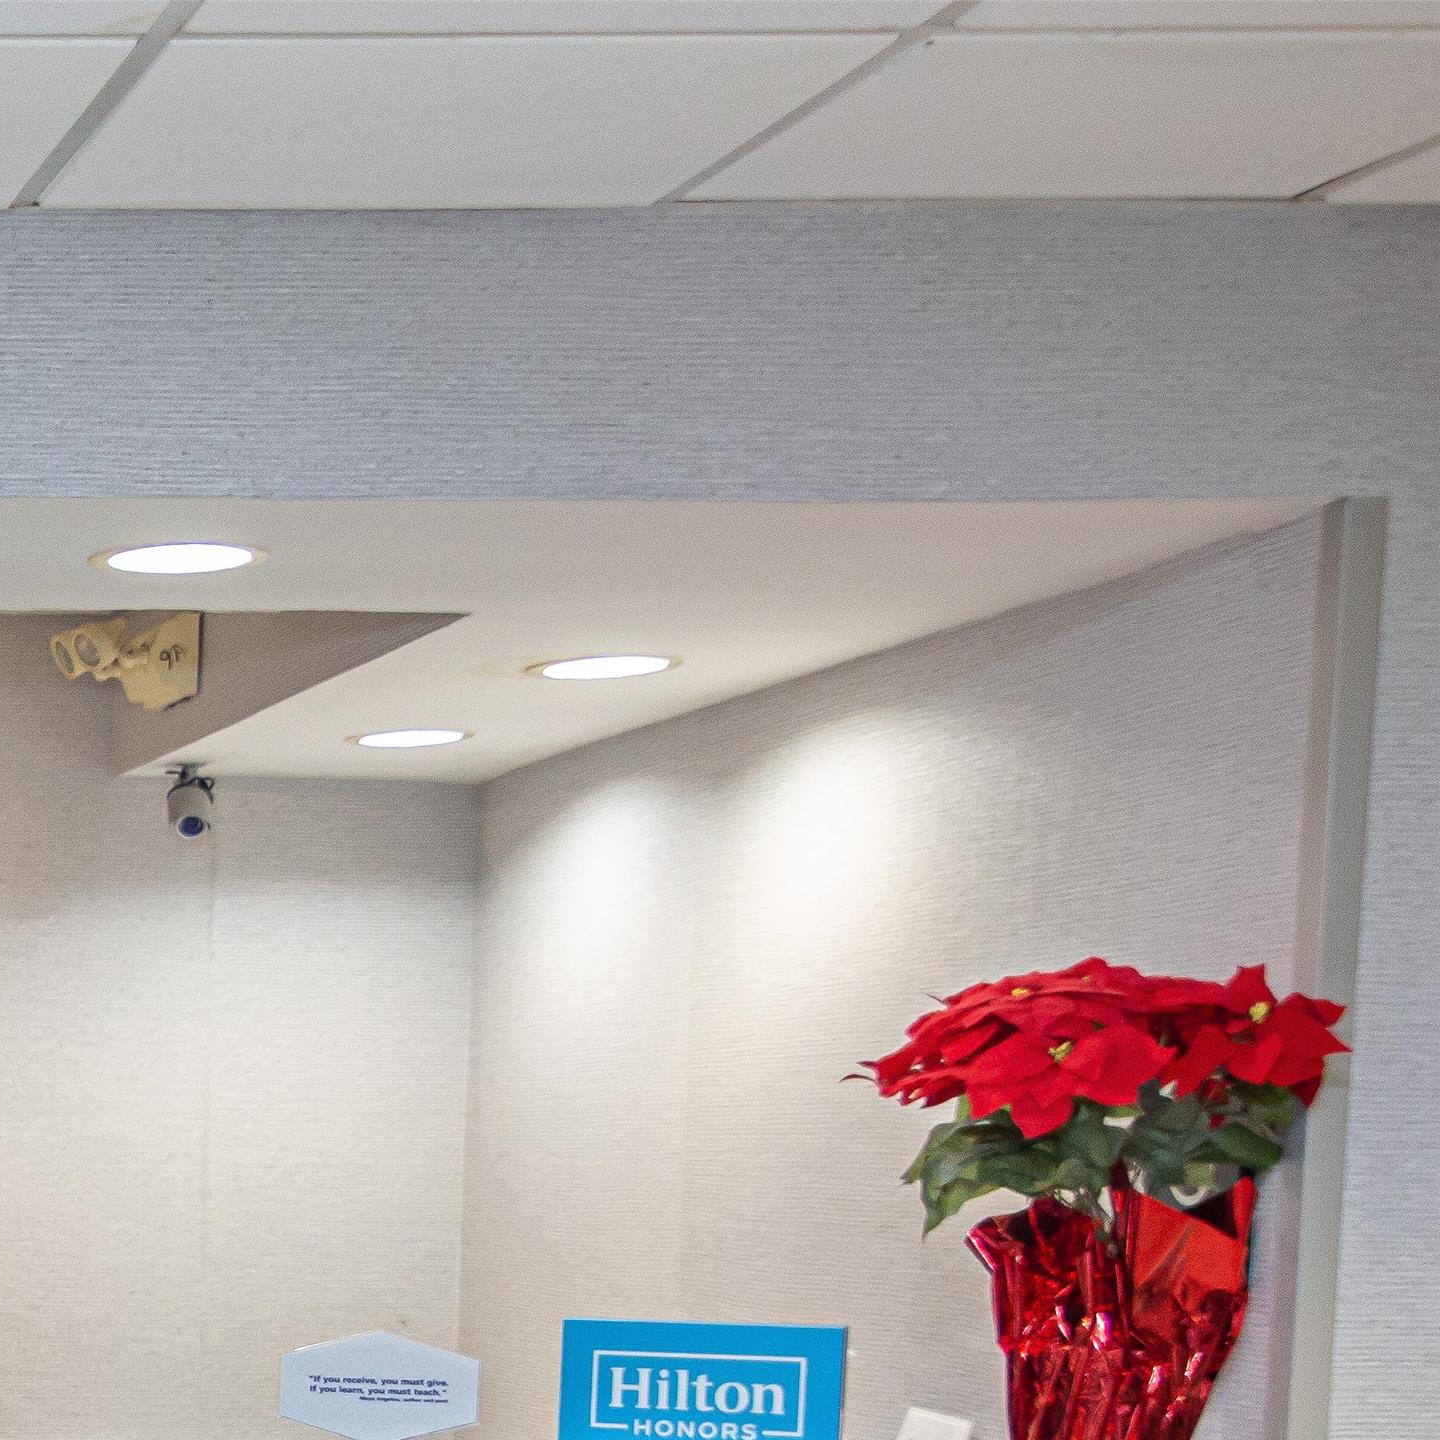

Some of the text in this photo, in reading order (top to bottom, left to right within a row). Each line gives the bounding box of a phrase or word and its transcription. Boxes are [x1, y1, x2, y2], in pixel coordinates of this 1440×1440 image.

[319, 1386, 337, 1394] you
[368, 1388, 386, 1396] you
[608, 1366, 785, 1415] Hilton
[633, 1418, 758, 1440] HONORS
